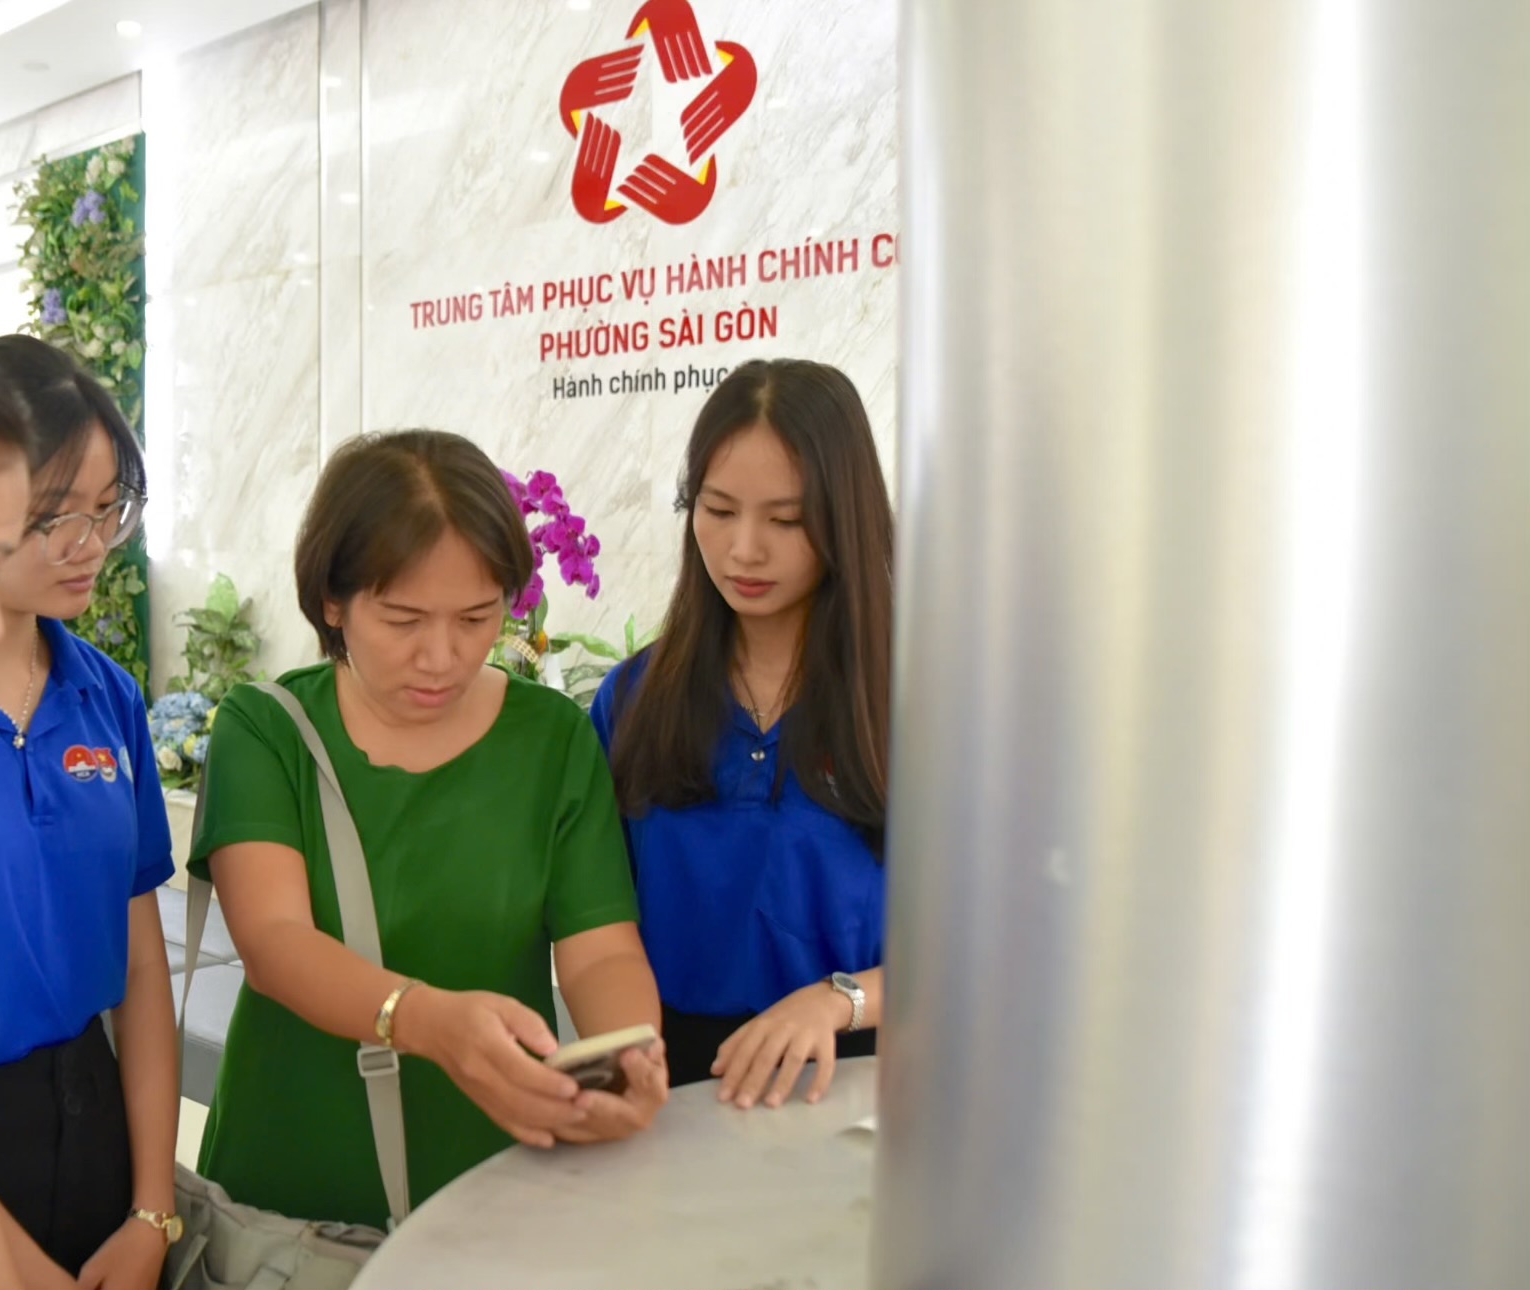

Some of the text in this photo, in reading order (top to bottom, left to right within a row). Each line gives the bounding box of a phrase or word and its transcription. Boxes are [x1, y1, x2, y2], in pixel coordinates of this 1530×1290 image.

[410, 233, 901, 329] TRUNG TÂM PHỤC VỤ HÀNH CHÍNH C
[540, 300, 777, 362] PHƯỜNG SÀI GÒN
[552, 374, 602, 400] Hành
[609, 366, 666, 395] chính
